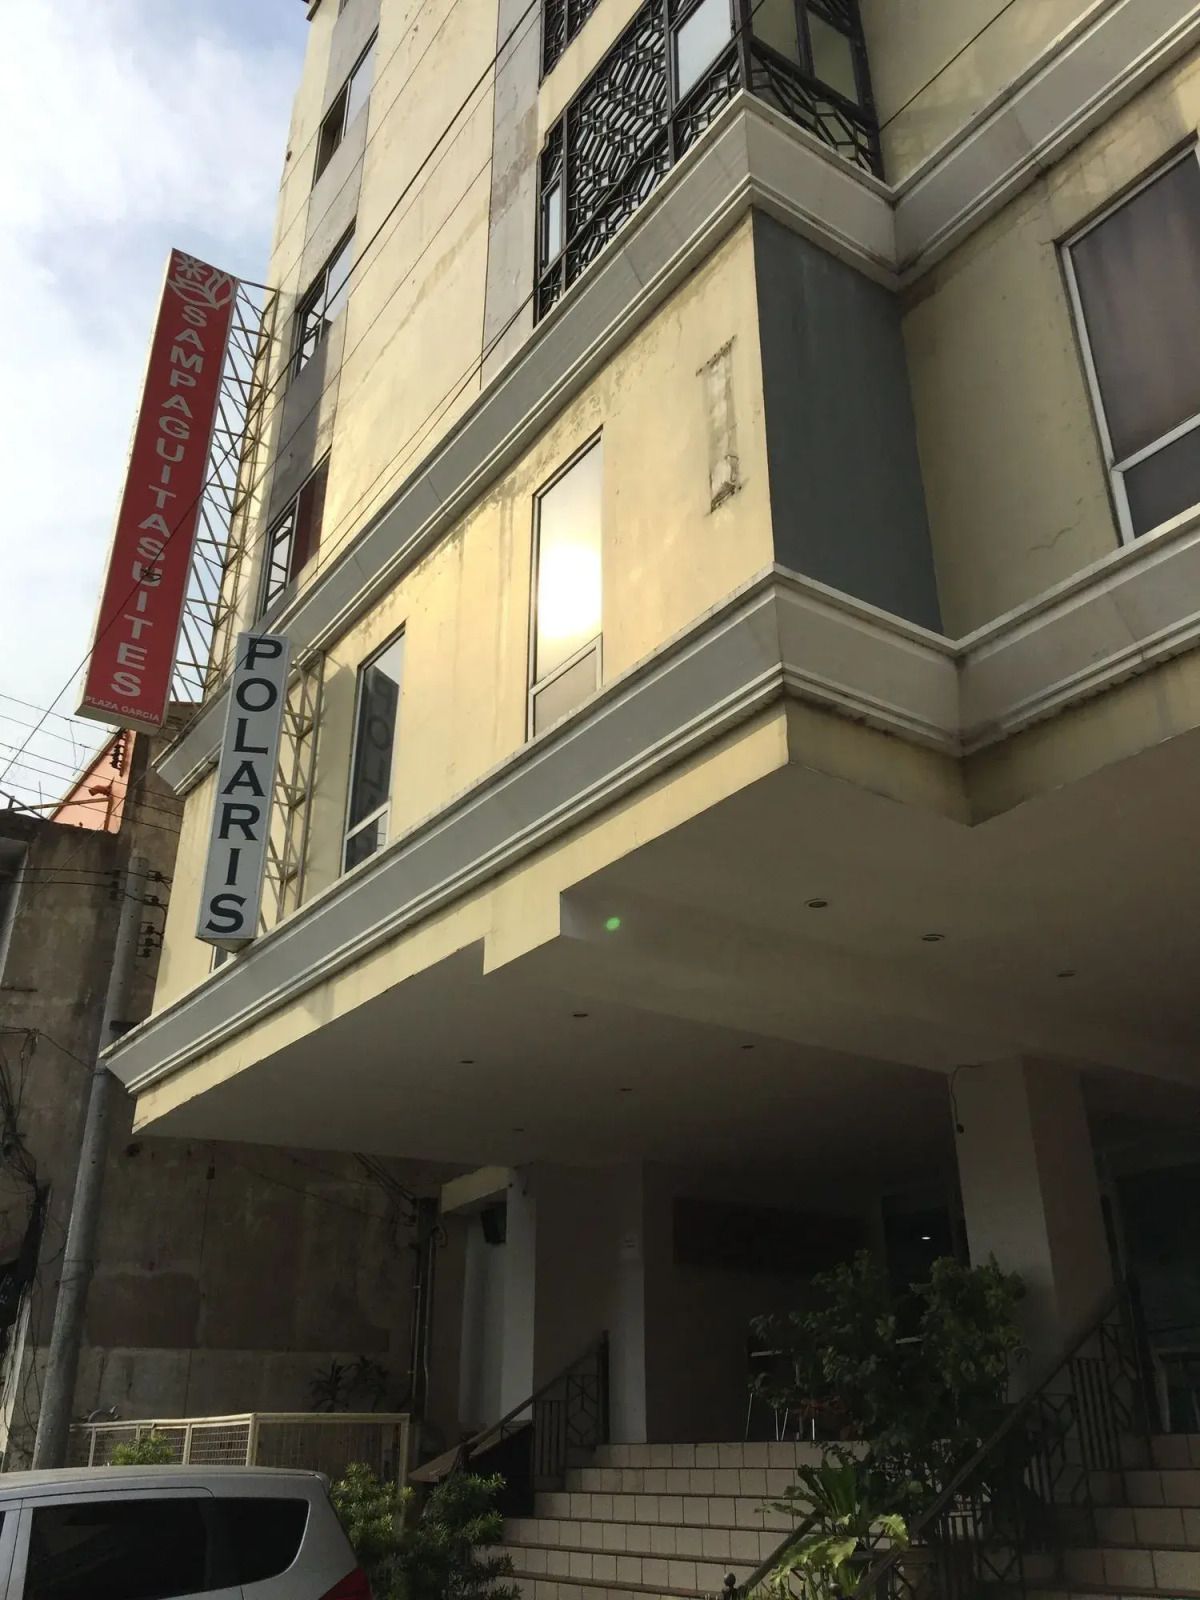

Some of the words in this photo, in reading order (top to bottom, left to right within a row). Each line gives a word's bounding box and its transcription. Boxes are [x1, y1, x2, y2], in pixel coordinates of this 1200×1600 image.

[85, 695, 119, 711] PLAZA
[121, 705, 160, 722] GARCIA
[205, 636, 283, 934] POLARIS
